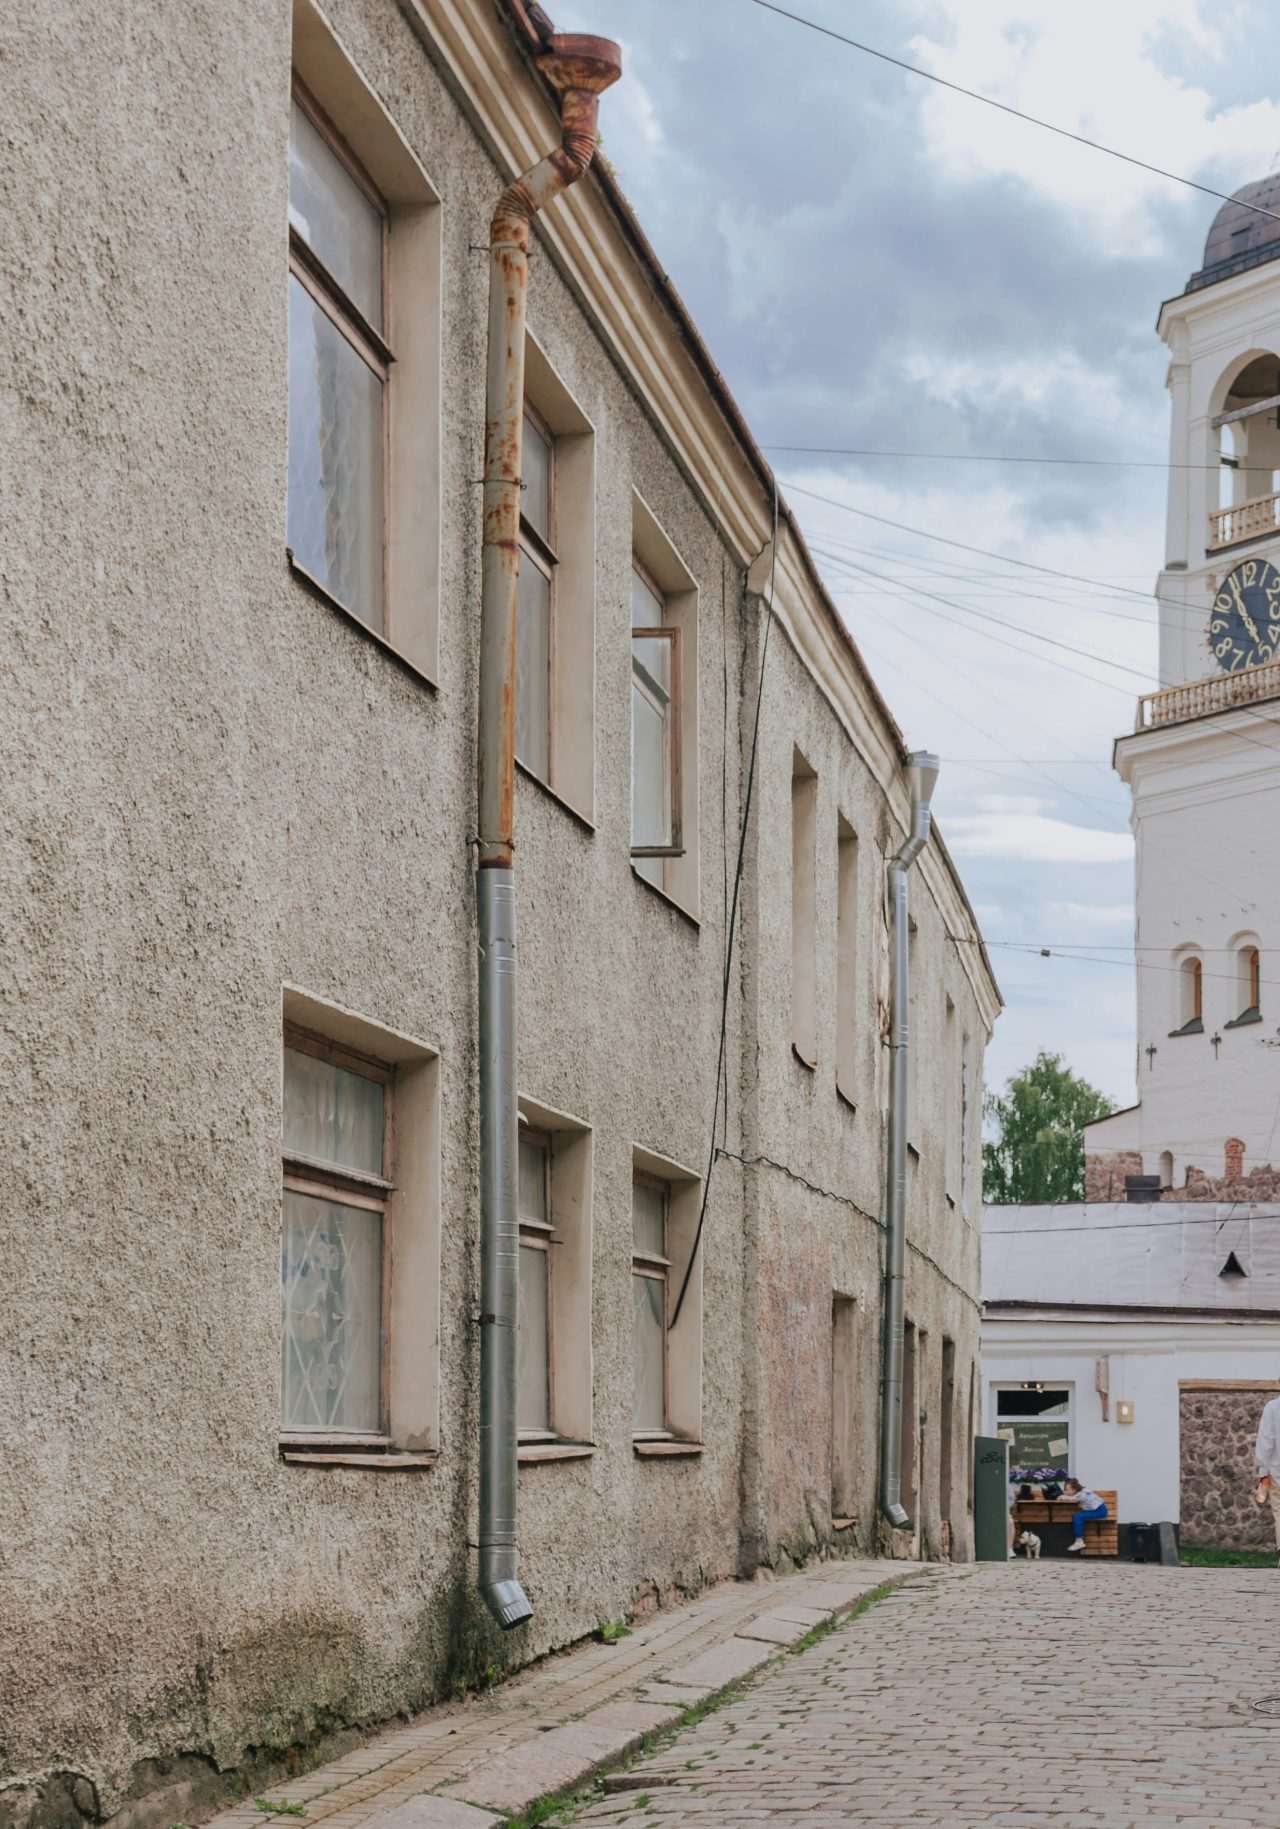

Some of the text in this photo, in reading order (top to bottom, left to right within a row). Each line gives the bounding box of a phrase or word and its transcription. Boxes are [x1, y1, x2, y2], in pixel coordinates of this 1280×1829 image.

[1242, 562, 1257, 588] 12
[1215, 594, 1232, 613] 10
[1212, 620, 1229, 634] 9
[1216, 637, 1232, 657] 8
[1231, 648, 1244, 671] 7
